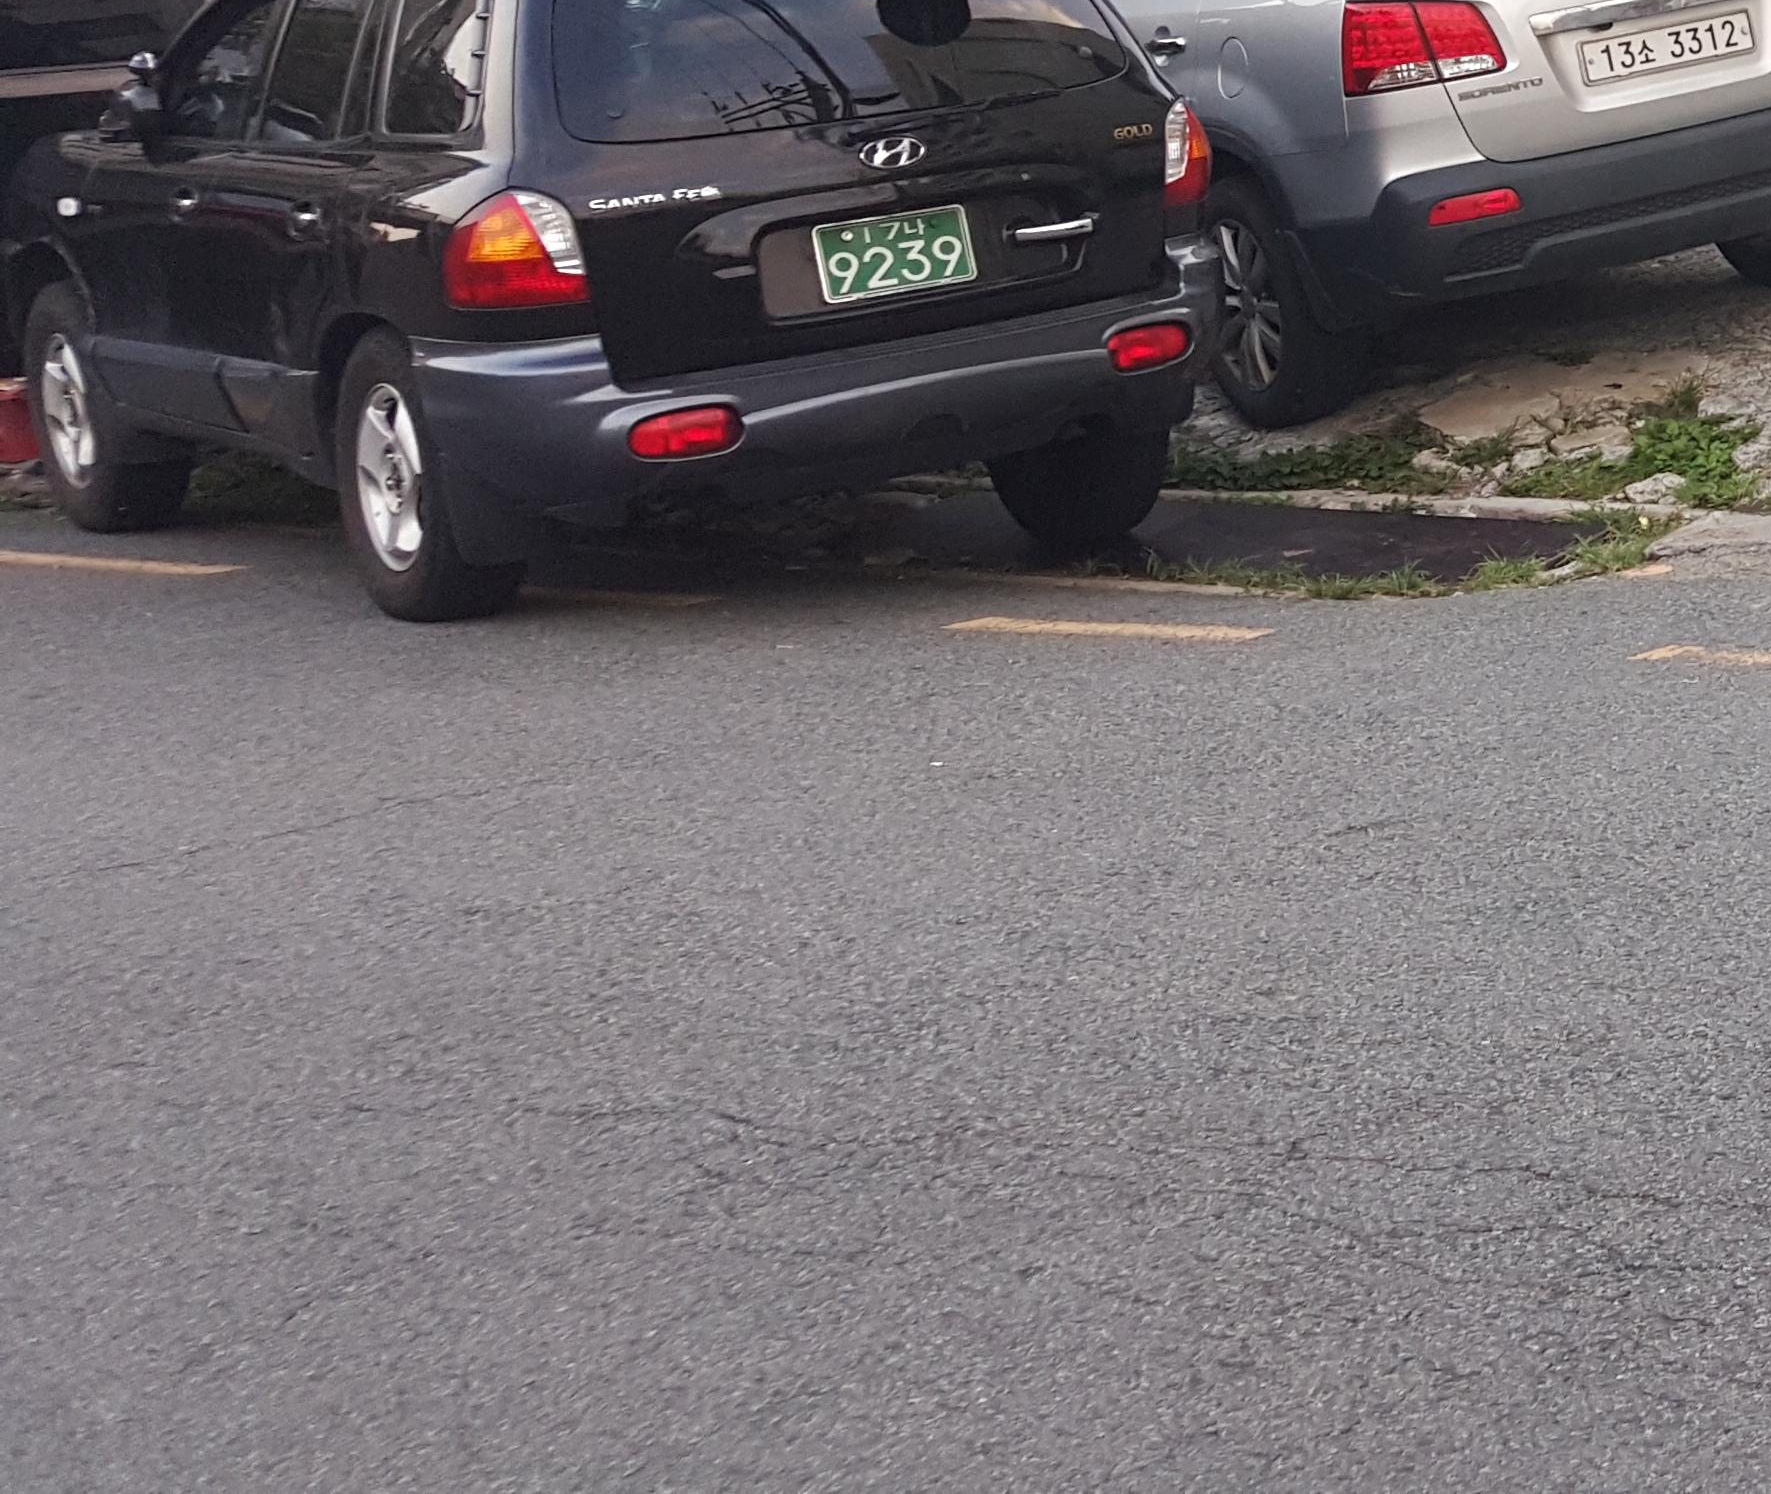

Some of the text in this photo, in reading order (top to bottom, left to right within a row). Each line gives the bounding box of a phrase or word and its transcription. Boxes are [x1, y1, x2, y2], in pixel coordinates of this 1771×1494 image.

[1599, 19, 1739, 73] 13소 3312
[1457, 77, 1544, 102] SORENTO
[1113, 123, 1153, 140] GOLD
[588, 192, 666, 213] SANTA
[863, 217, 926, 244] 17나
[827, 234, 963, 295] 9239
